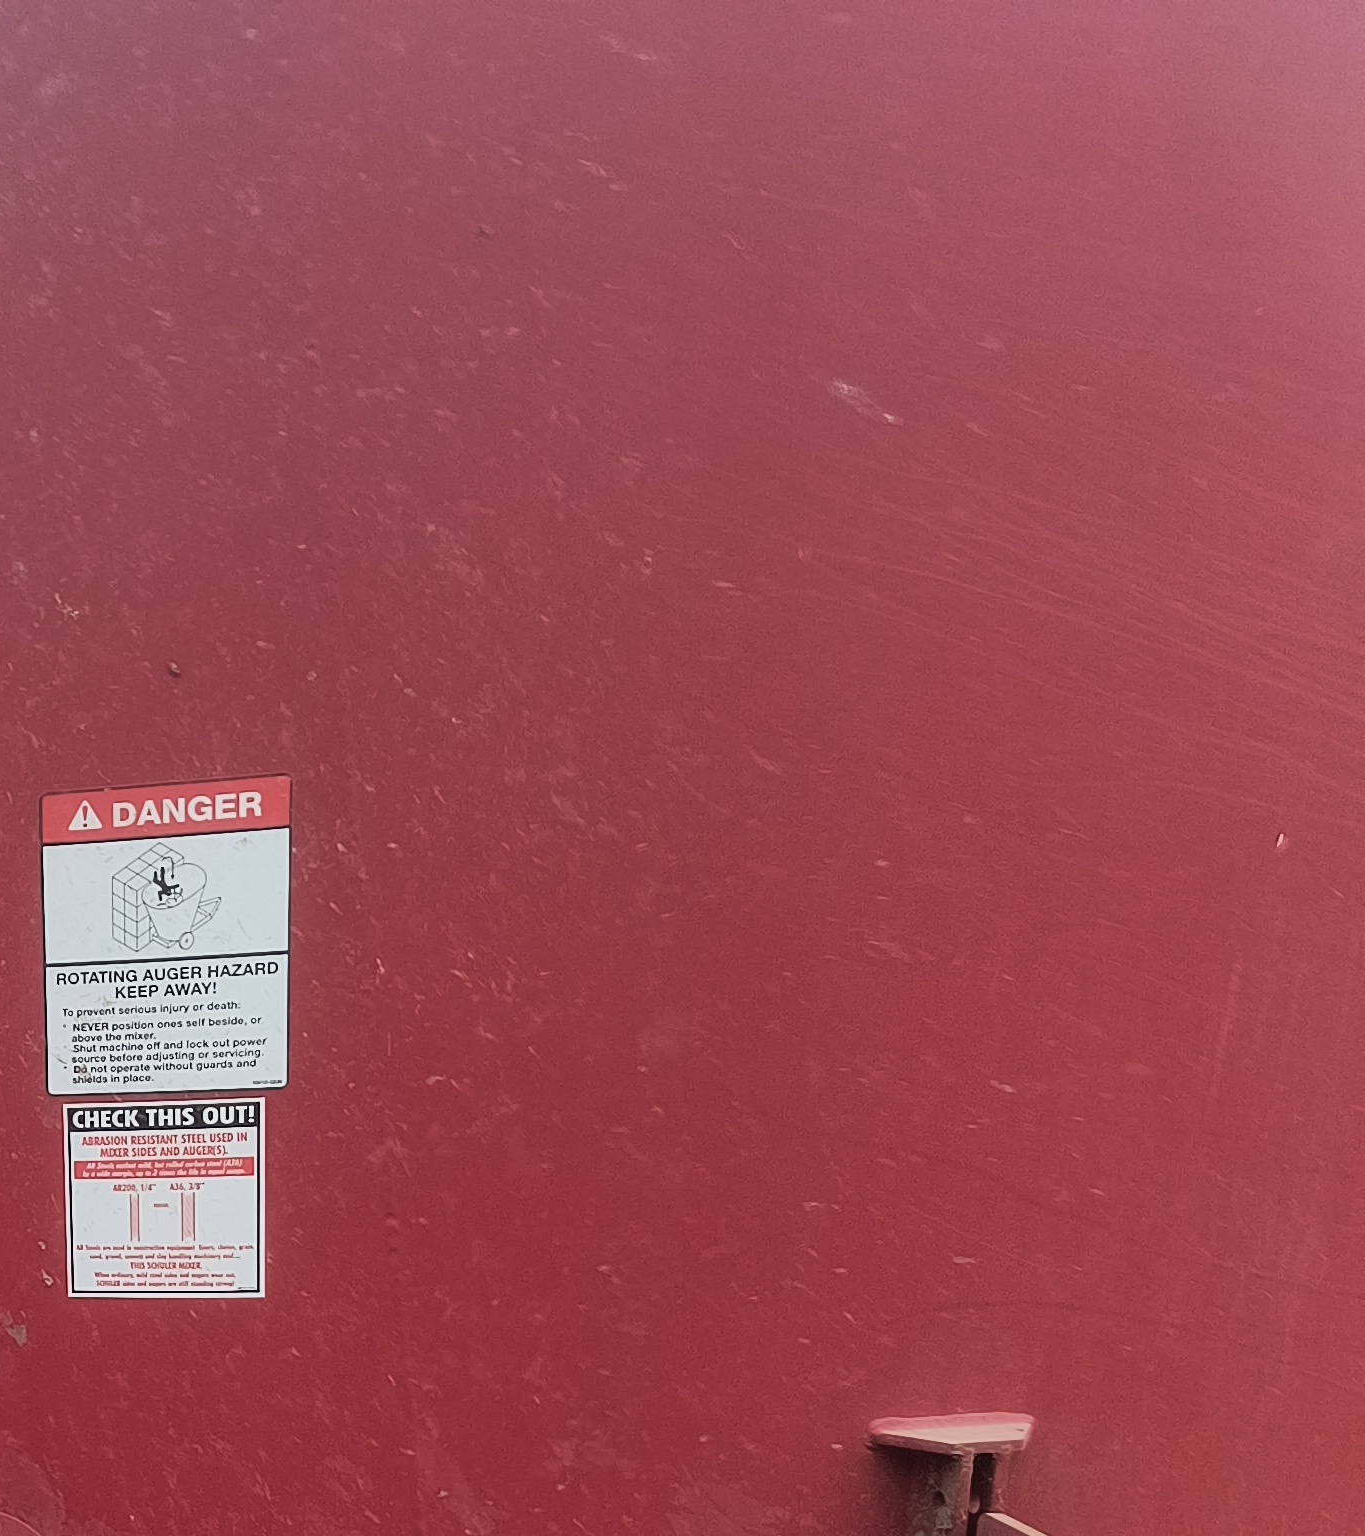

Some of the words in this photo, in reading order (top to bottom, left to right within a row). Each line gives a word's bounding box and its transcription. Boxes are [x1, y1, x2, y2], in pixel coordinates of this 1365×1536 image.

[112, 792, 261, 828] DANGER
[56, 969, 138, 985] ROTATING
[143, 967, 202, 982] AUGER
[208, 962, 279, 978] HAZARD
[115, 985, 159, 999] KEEP
[164, 982, 217, 997] AWAY!
[63, 1008, 74, 1017] To
[77, 1007, 115, 1018] prevent
[119, 1006, 157, 1015] serious
[160, 1004, 190, 1015] injury
[193, 1004, 205, 1012] or
[207, 1002, 242, 1011] death:
[73, 1022, 109, 1032] NEVER
[112, 1021, 154, 1032] position
[186, 1018, 205, 1028] self
[208, 1017, 248, 1027] beside,
[251, 1017, 262, 1025] or
[72, 1034, 103, 1043] above
[105, 1033, 122, 1041] the
[124, 1032, 157, 1041] mixer.
[73, 1044, 97, 1053] Shut
[100, 1043, 144, 1052] machine
[147, 1041, 161, 1050] off
[164, 1041, 183, 1050] and
[187, 1040, 209, 1049] lock
[213, 1039, 230, 1048] out
[233, 1038, 267, 1048] power
[72, 1056, 107, 1064] source
[110, 1053, 143, 1063] before
[146, 1051, 195, 1063] adjusting
[213, 1049, 265, 1060] servicing.
[74, 1064, 88, 1074] Do
[90, 1065, 107, 1073] not
[110, 1063, 151, 1073] operate
[154, 1062, 194, 1071] without
[197, 1060, 233, 1072] guards
[237, 1059, 257, 1069] and
[73, 1075, 108, 1084] shields
[111, 1075, 121, 1083] in
[123, 1074, 155, 1084] place.
[72, 1109, 140, 1129] CHECK
[146, 1108, 195, 1127] THIS
[203, 1106, 255, 1125] OUT!
[82, 1136, 128, 1146] ABRASION
[131, 1134, 178, 1145] RESISTANT
[182, 1133, 207, 1144] STEEL
[210, 1133, 234, 1143] USED
[237, 1132, 248, 1142] IN
[100, 1148, 130, 1158] MIXER
[132, 1147, 158, 1157] SIDES
[160, 1146, 180, 1157] AND
[183, 1145, 229, 1157] AUGER(S).
[170, 1183, 187, 1192] A36,
[147, 1262, 176, 1270] SCHULER
